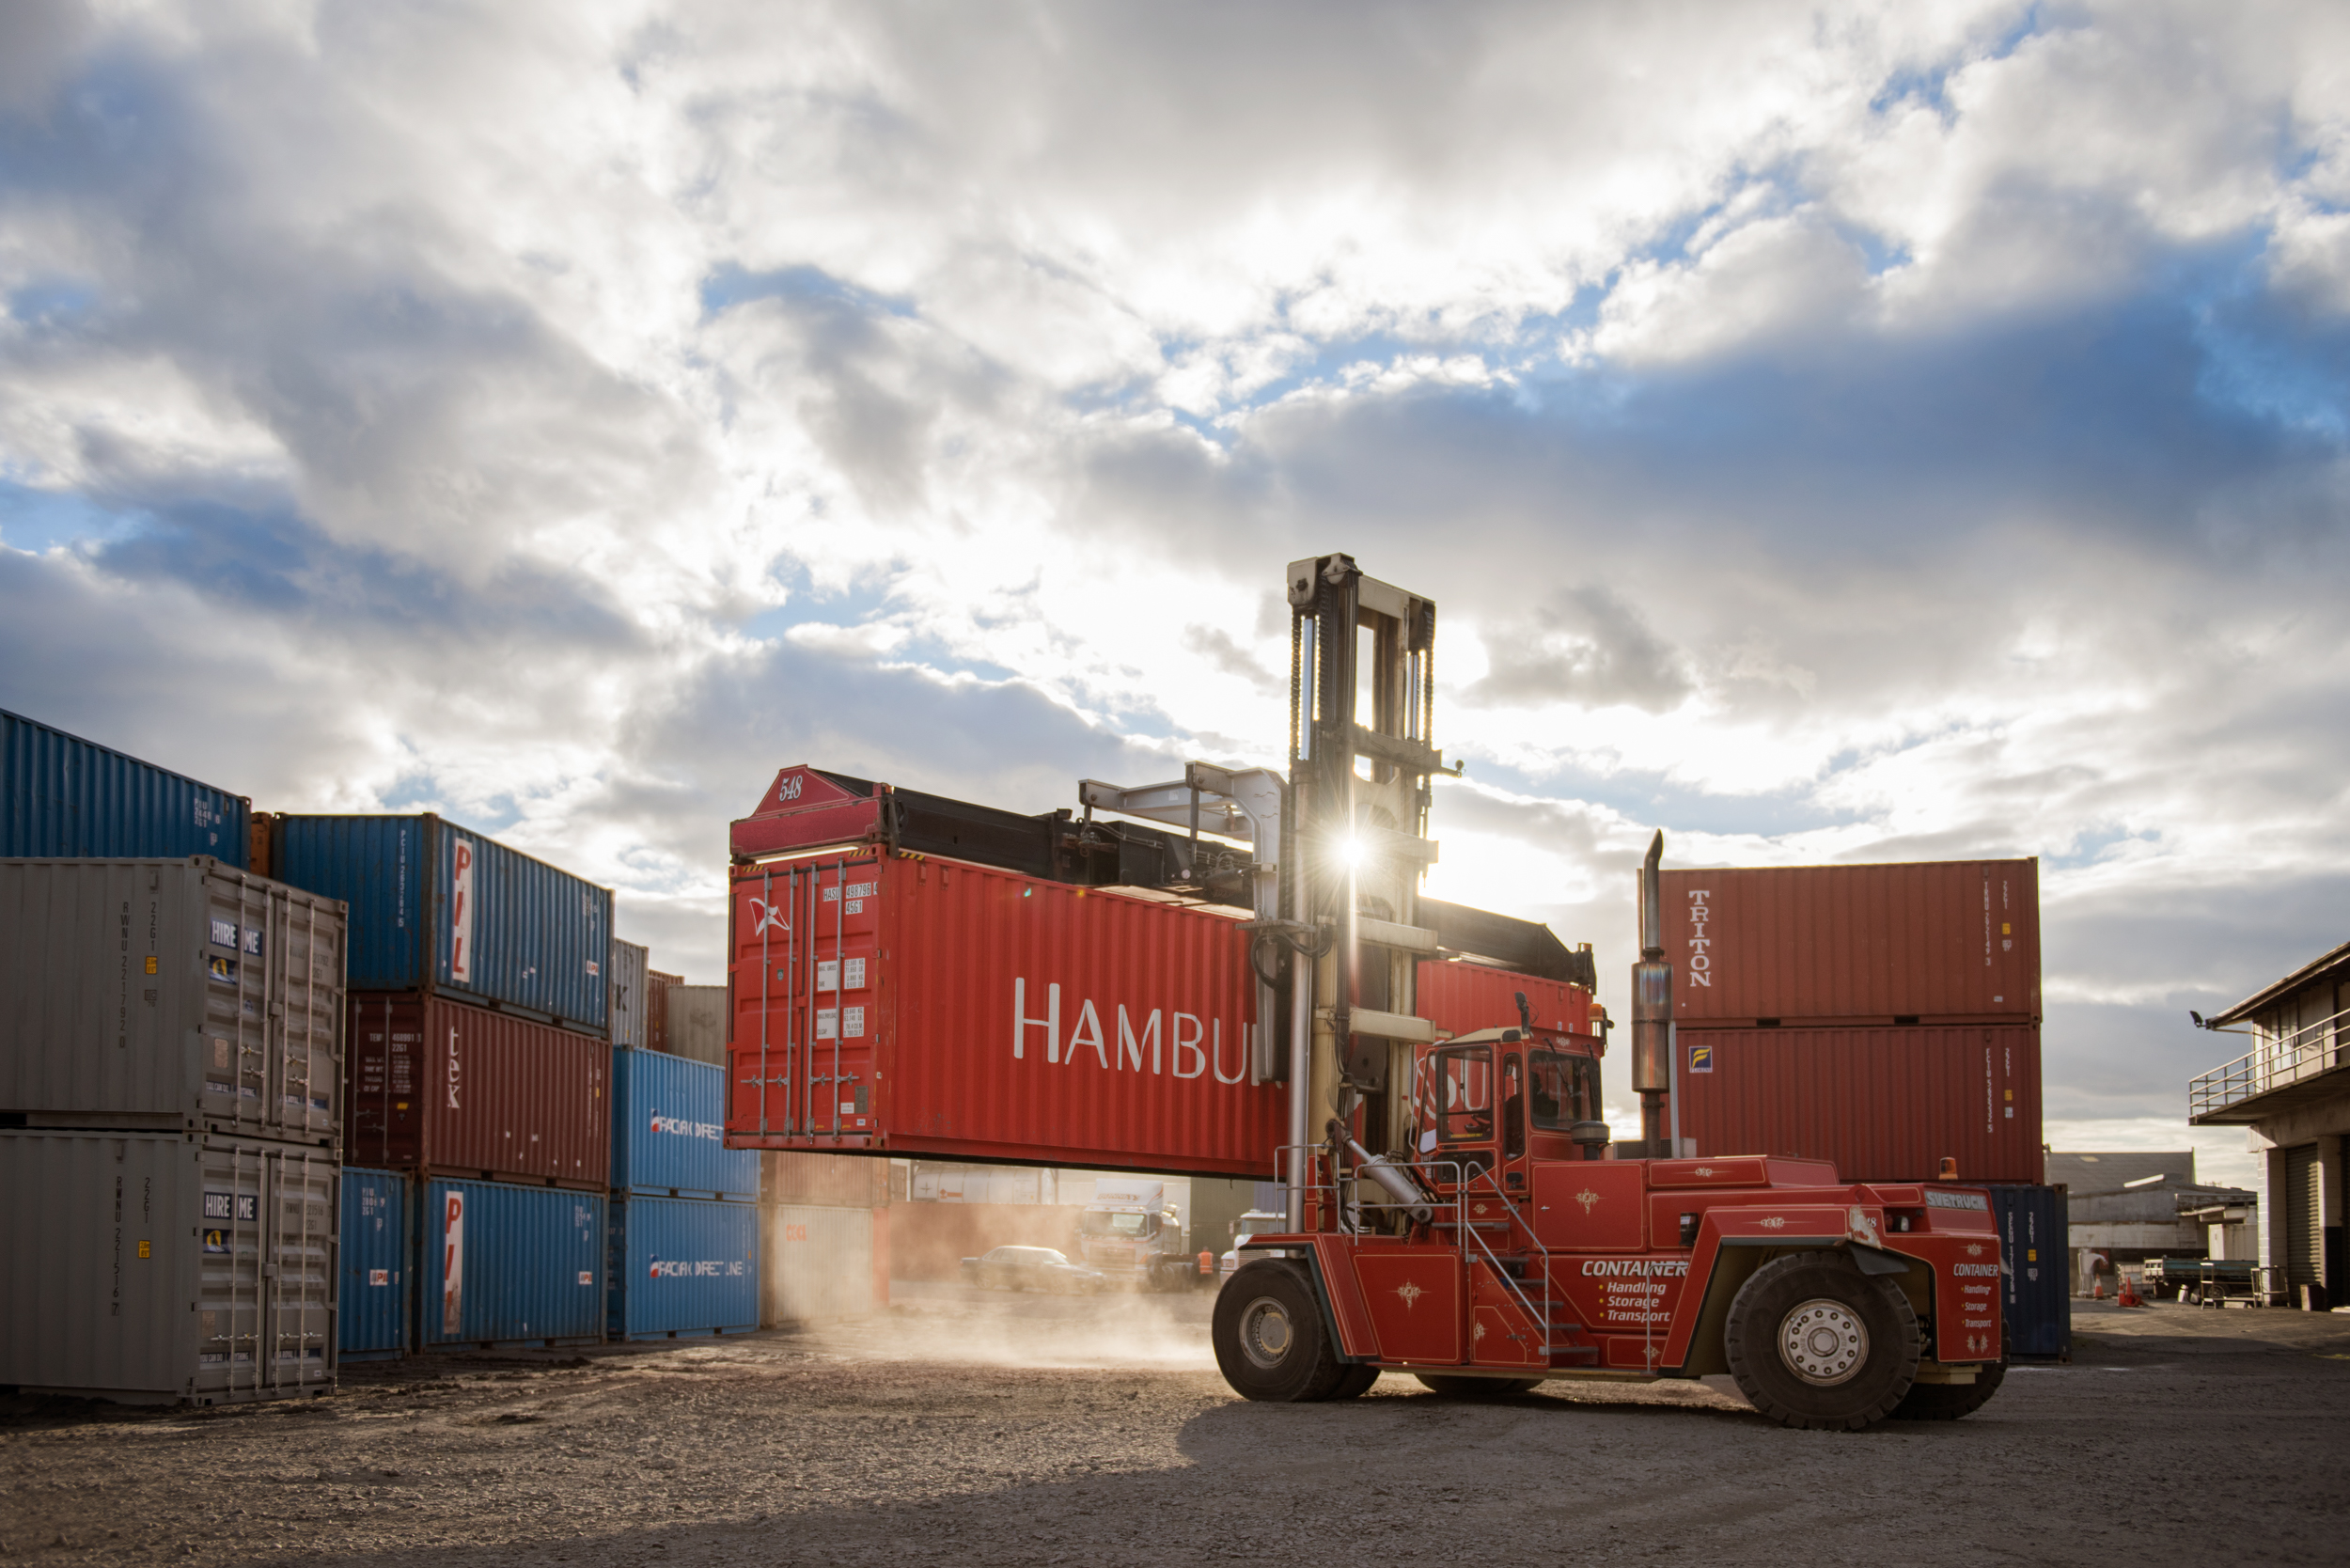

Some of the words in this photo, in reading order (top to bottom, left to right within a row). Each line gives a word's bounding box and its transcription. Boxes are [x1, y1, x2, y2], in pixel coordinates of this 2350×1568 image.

[779, 775, 804, 802] 548
[824, 888, 841, 901] HASU
[846, 884, 871, 899] 498796
[453, 845, 472, 974] PIL
[846, 901, 862, 914] 45G1
[120, 902, 130, 951] RWNU
[212, 920, 236, 949] HIRE
[243, 929, 259, 953] ME
[1688, 889, 1712, 988] TRITON
[119, 955, 129, 1031] 221792
[1014, 977, 1261, 1087] HAMBU
[447, 1026, 461, 1109] tex
[115, 1176, 123, 1223] RWNU
[205, 1194, 231, 1218] HIRE
[238, 1196, 254, 1219] ME
[1581, 1260, 1689, 1278] CONTAINER
[1953, 1263, 1998, 1278] CONTAINER
[1606, 1281, 1667, 1295] Handlng
[1964, 1285, 1991, 1295] Handling
[1606, 1295, 1660, 1309] Storage
[1965, 1302, 1988, 1313] Storage
[1606, 1309, 1671, 1324] Transport
[1965, 1318, 1992, 1329] Transport
